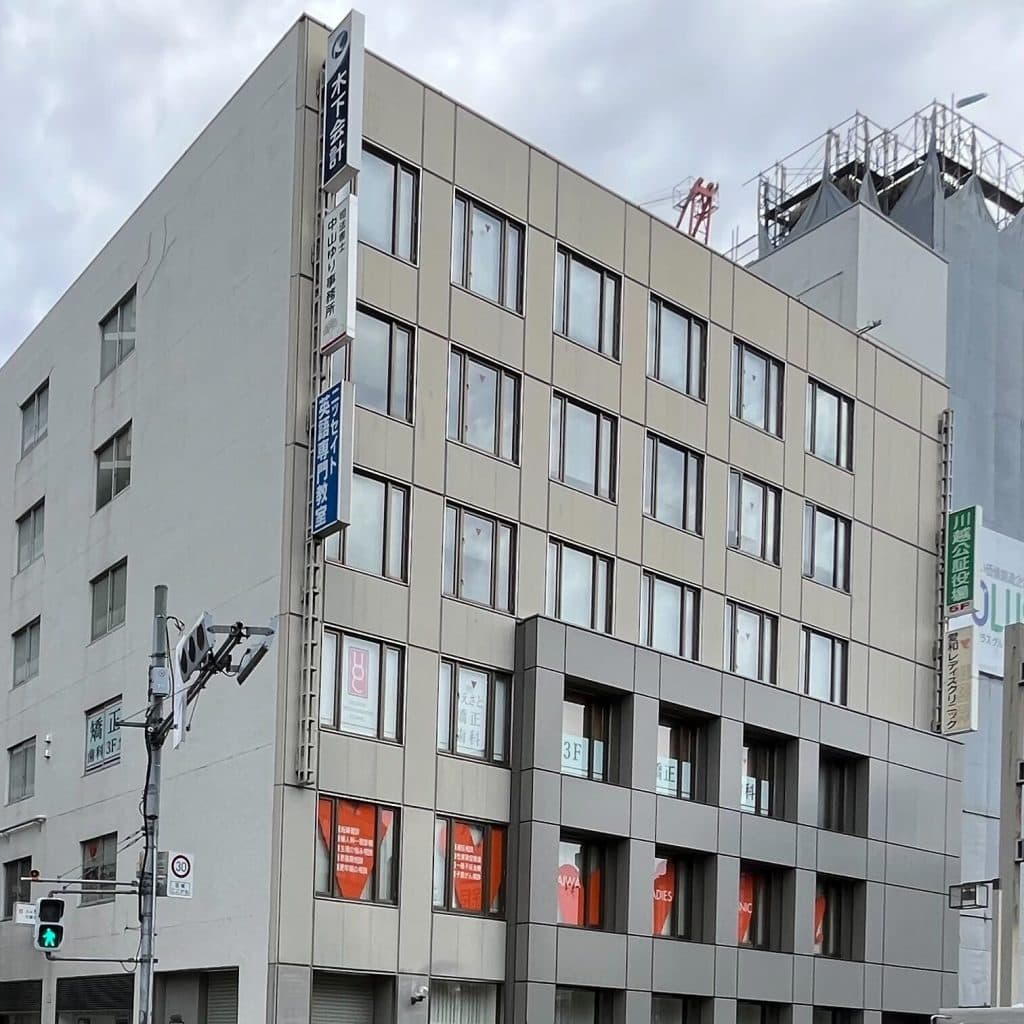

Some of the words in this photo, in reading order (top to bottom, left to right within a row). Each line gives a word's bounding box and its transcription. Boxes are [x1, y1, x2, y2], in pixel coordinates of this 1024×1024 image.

[329, 69, 347, 170] 木下会計
[325, 216, 337, 319] 中山ゆり事務所
[951, 512, 972, 602] 川越公証役場
[563, 740, 583, 761] 3F
[175, 861, 187, 872] 30
